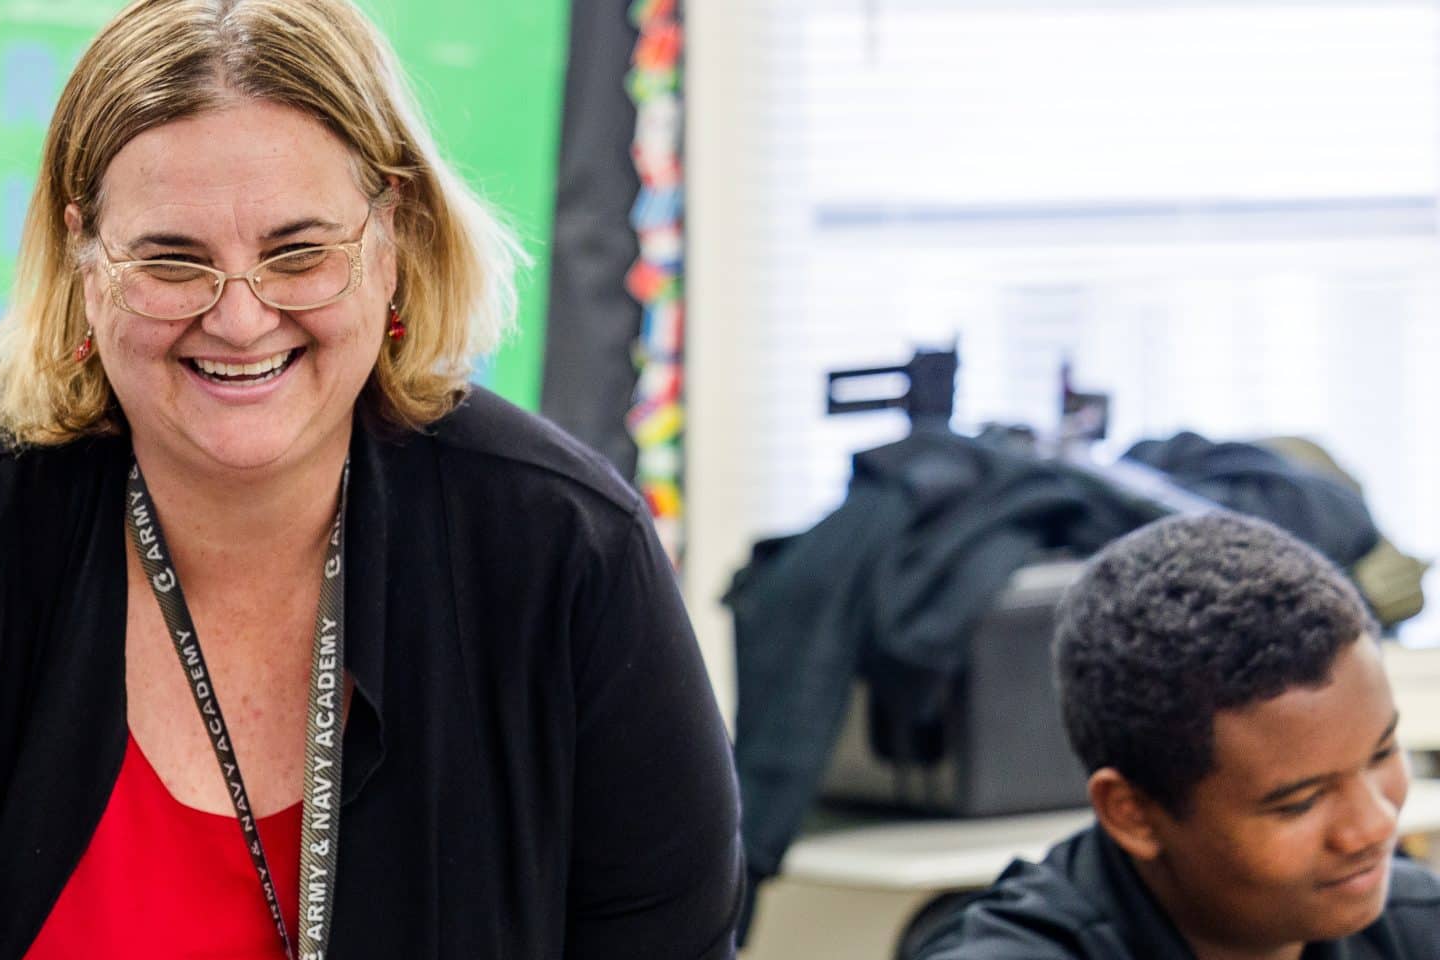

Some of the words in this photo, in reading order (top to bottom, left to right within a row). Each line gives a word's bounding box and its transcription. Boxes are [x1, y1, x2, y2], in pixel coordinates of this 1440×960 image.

[129, 490, 163, 560] ARMY
[175, 629, 229, 752] ACADEMY
[315, 617, 337, 748] ACADEMY
[223, 761, 253, 832] NAVY
[310, 757, 333, 829] NAVY
[309, 838, 330, 856] &
[307, 860, 328, 941] ARMY
